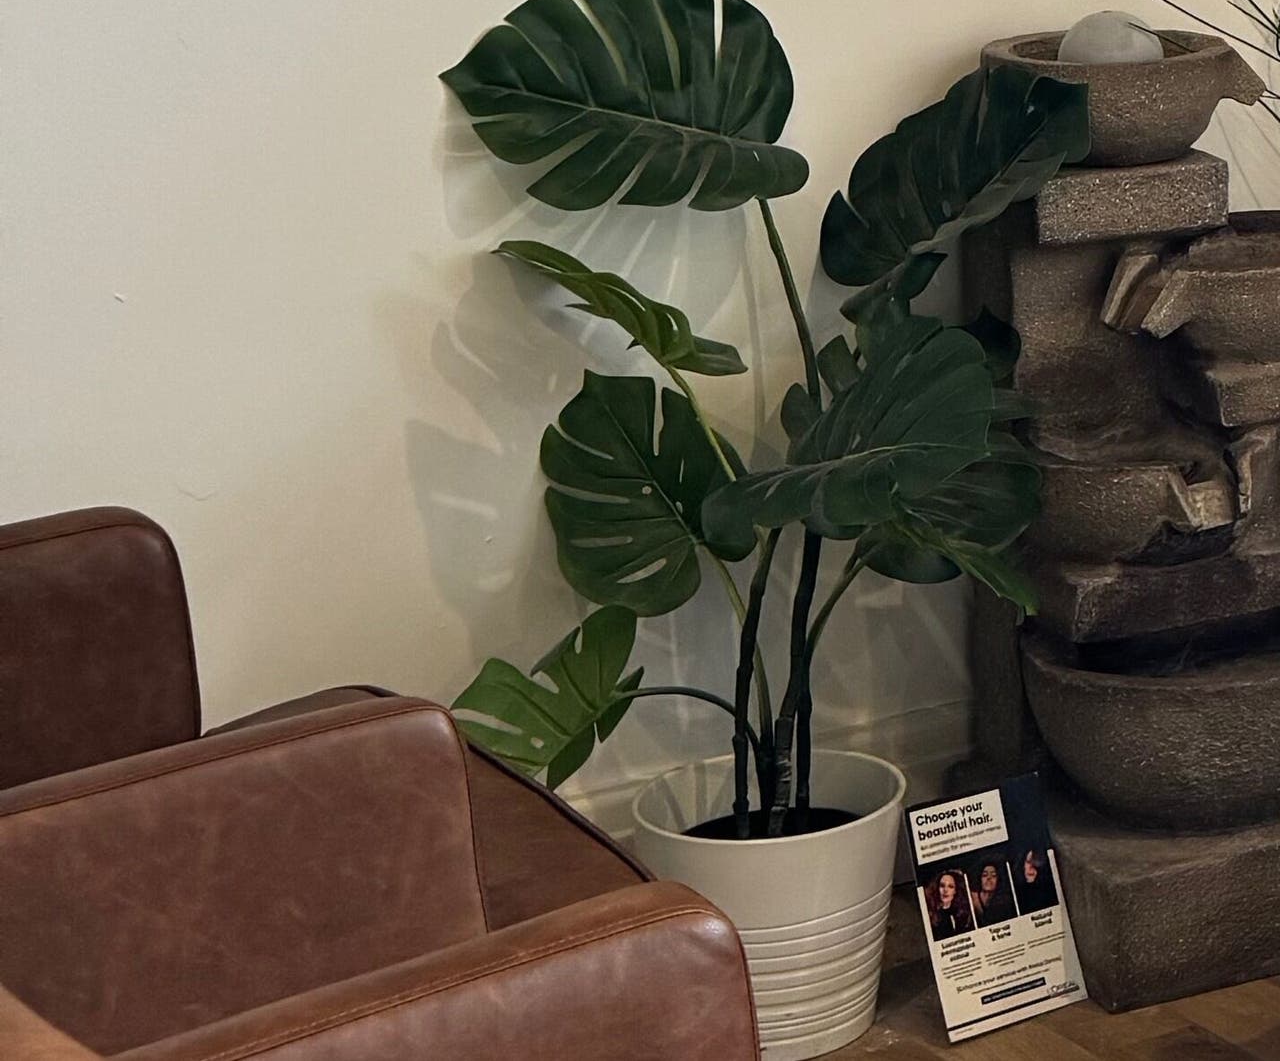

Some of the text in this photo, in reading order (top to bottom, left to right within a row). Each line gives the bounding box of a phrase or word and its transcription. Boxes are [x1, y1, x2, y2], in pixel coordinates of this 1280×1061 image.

[915, 801, 983, 826] Choose your
[917, 812, 993, 841] beautiful hair.
